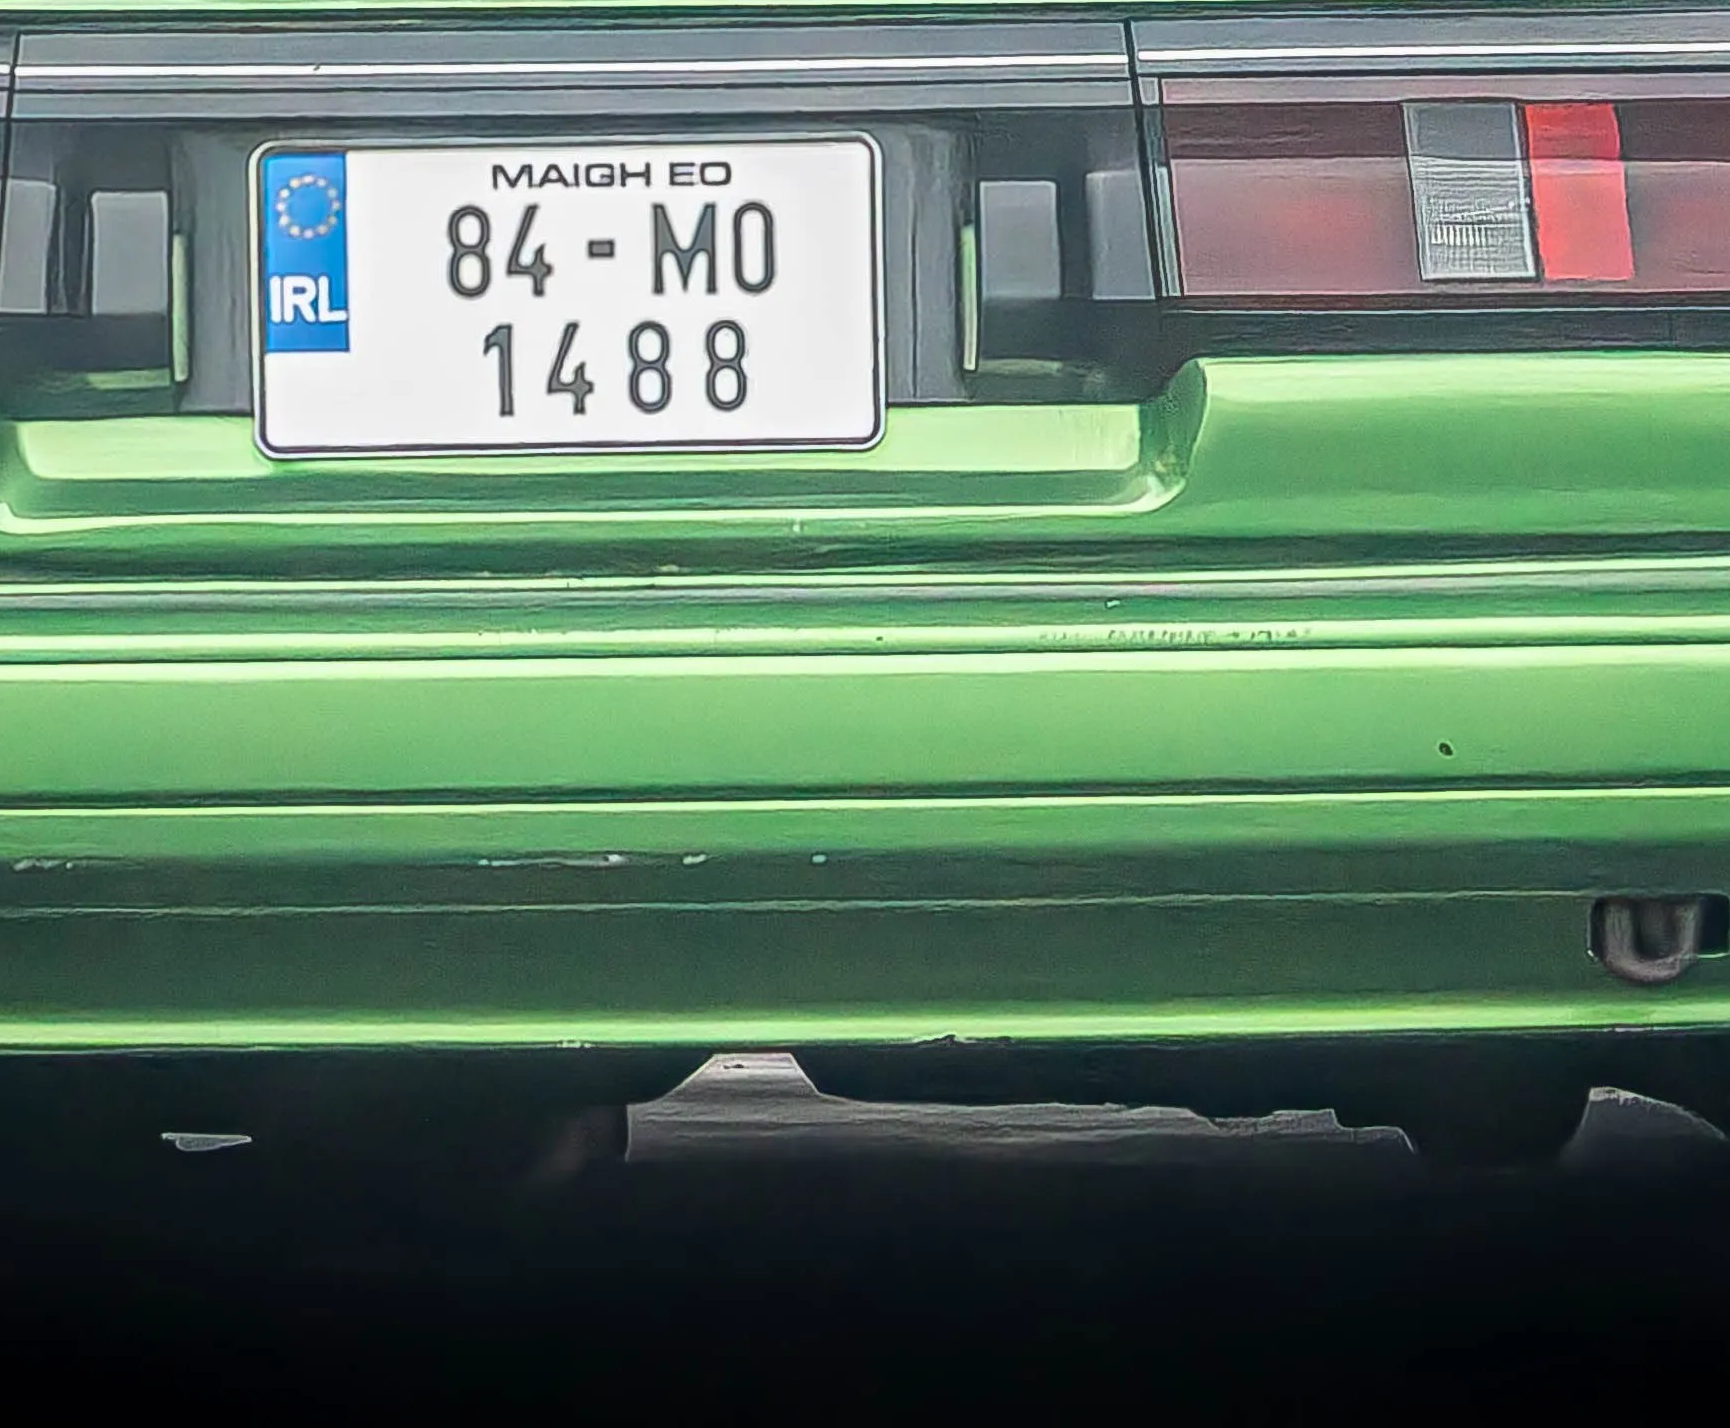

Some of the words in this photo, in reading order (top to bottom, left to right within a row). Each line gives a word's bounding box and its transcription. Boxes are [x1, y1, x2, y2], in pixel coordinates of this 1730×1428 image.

[491, 162, 653, 189] MAIGH
[667, 161, 733, 187] EO
[270, 275, 348, 324] IRL
[482, 318, 750, 417] 1488
